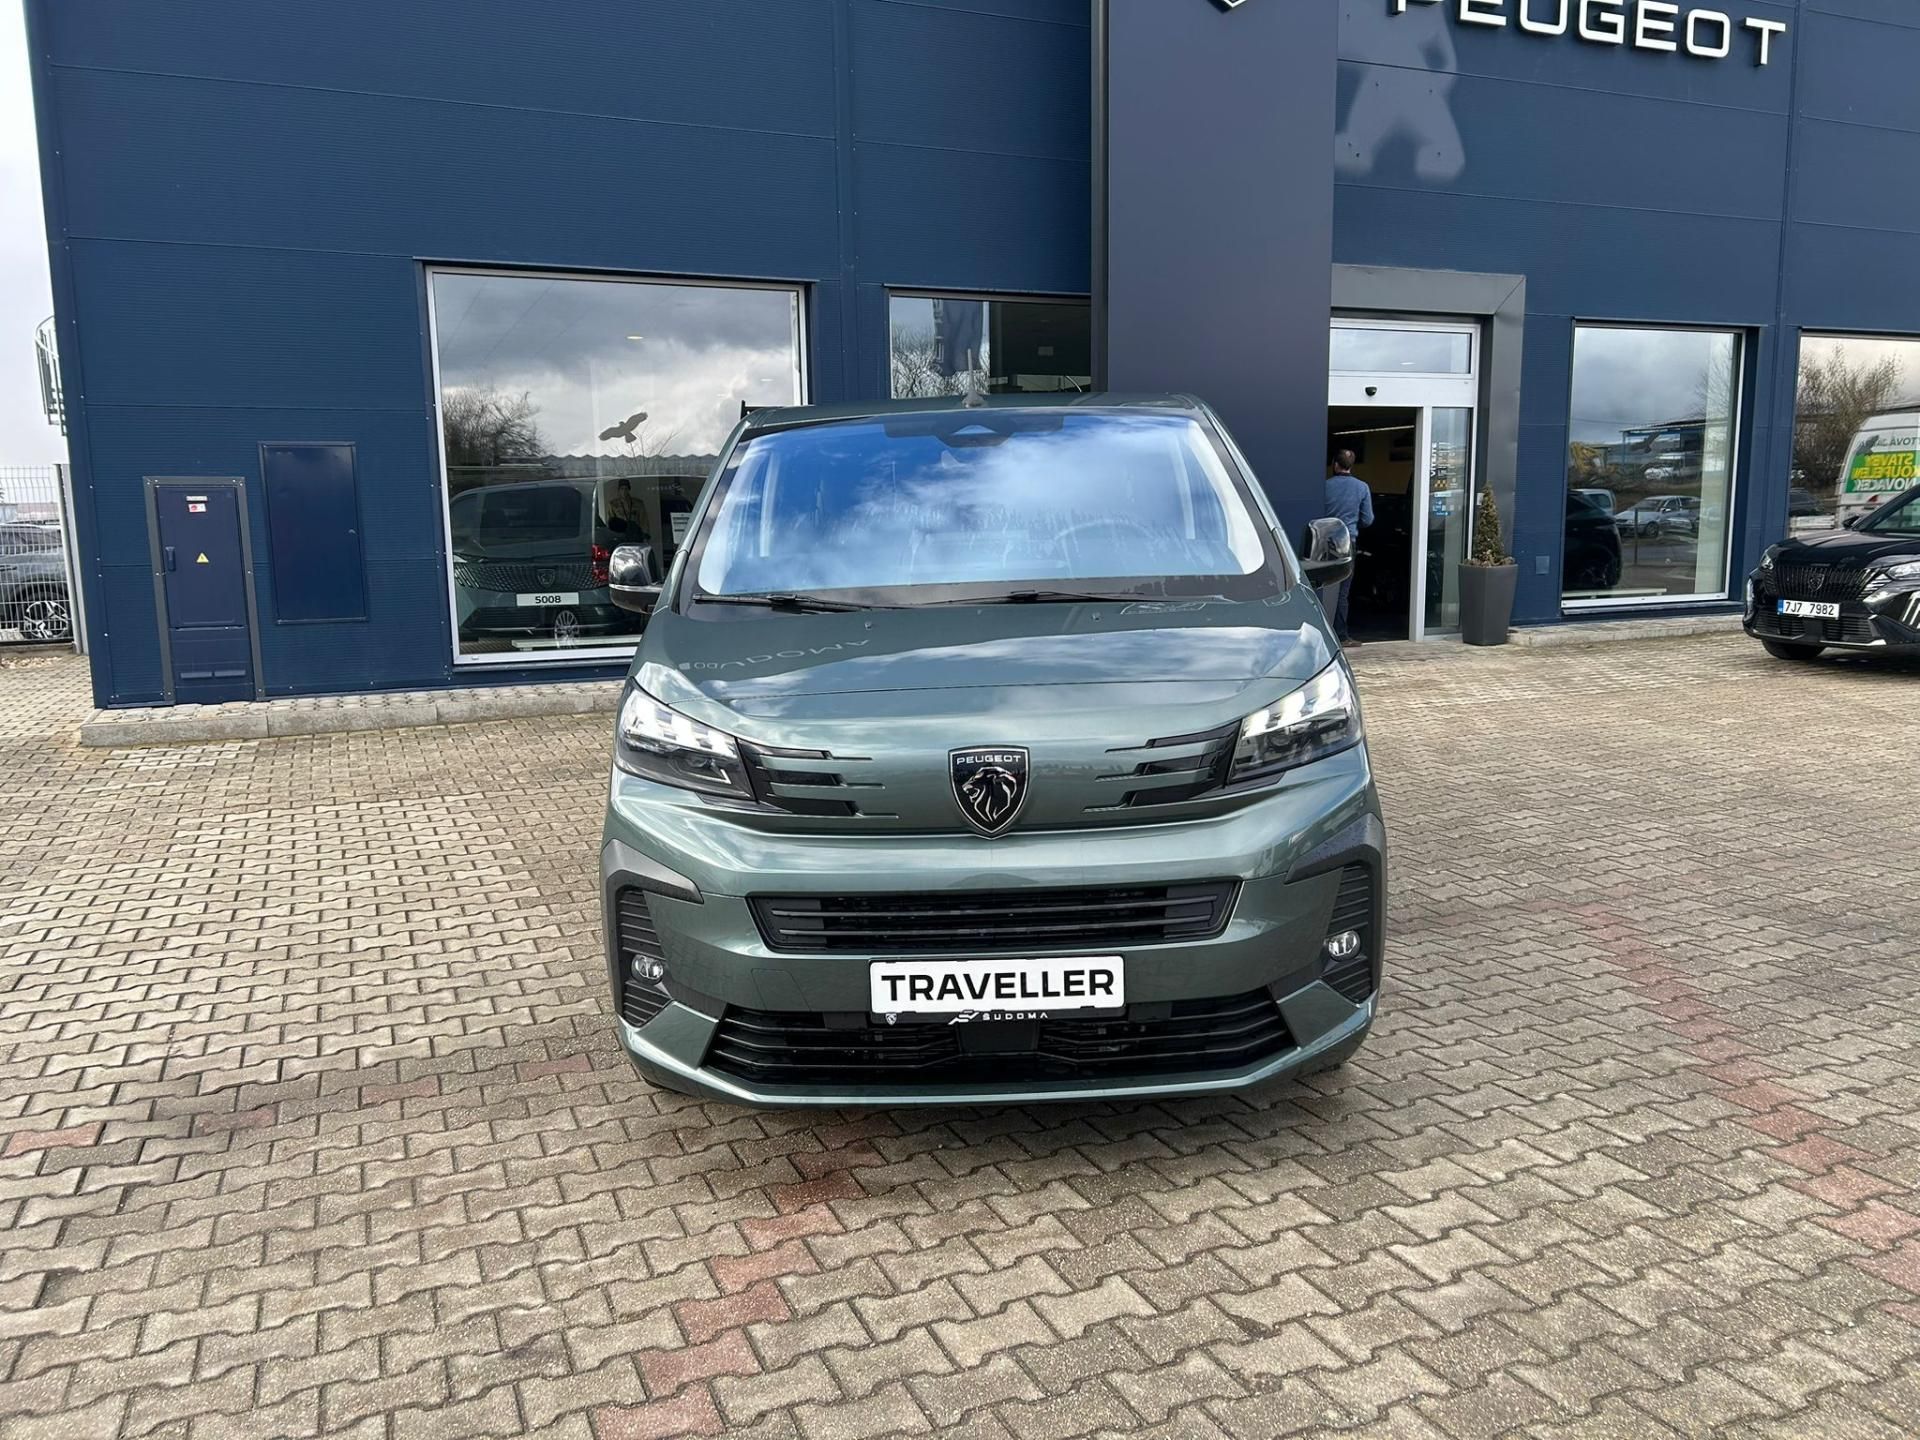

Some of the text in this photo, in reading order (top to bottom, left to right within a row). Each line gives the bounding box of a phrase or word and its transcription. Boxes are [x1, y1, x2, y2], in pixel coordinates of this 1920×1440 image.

[1394, 0, 1786, 65] EUGEOT
[535, 595, 561, 604] 5008
[1785, 601, 1835, 616] 7J7 7982
[956, 754, 1022, 765] PEUGEOT
[880, 968, 1115, 1002] TRAVELLER
[982, 1012, 1049, 1021] SUDOMA
